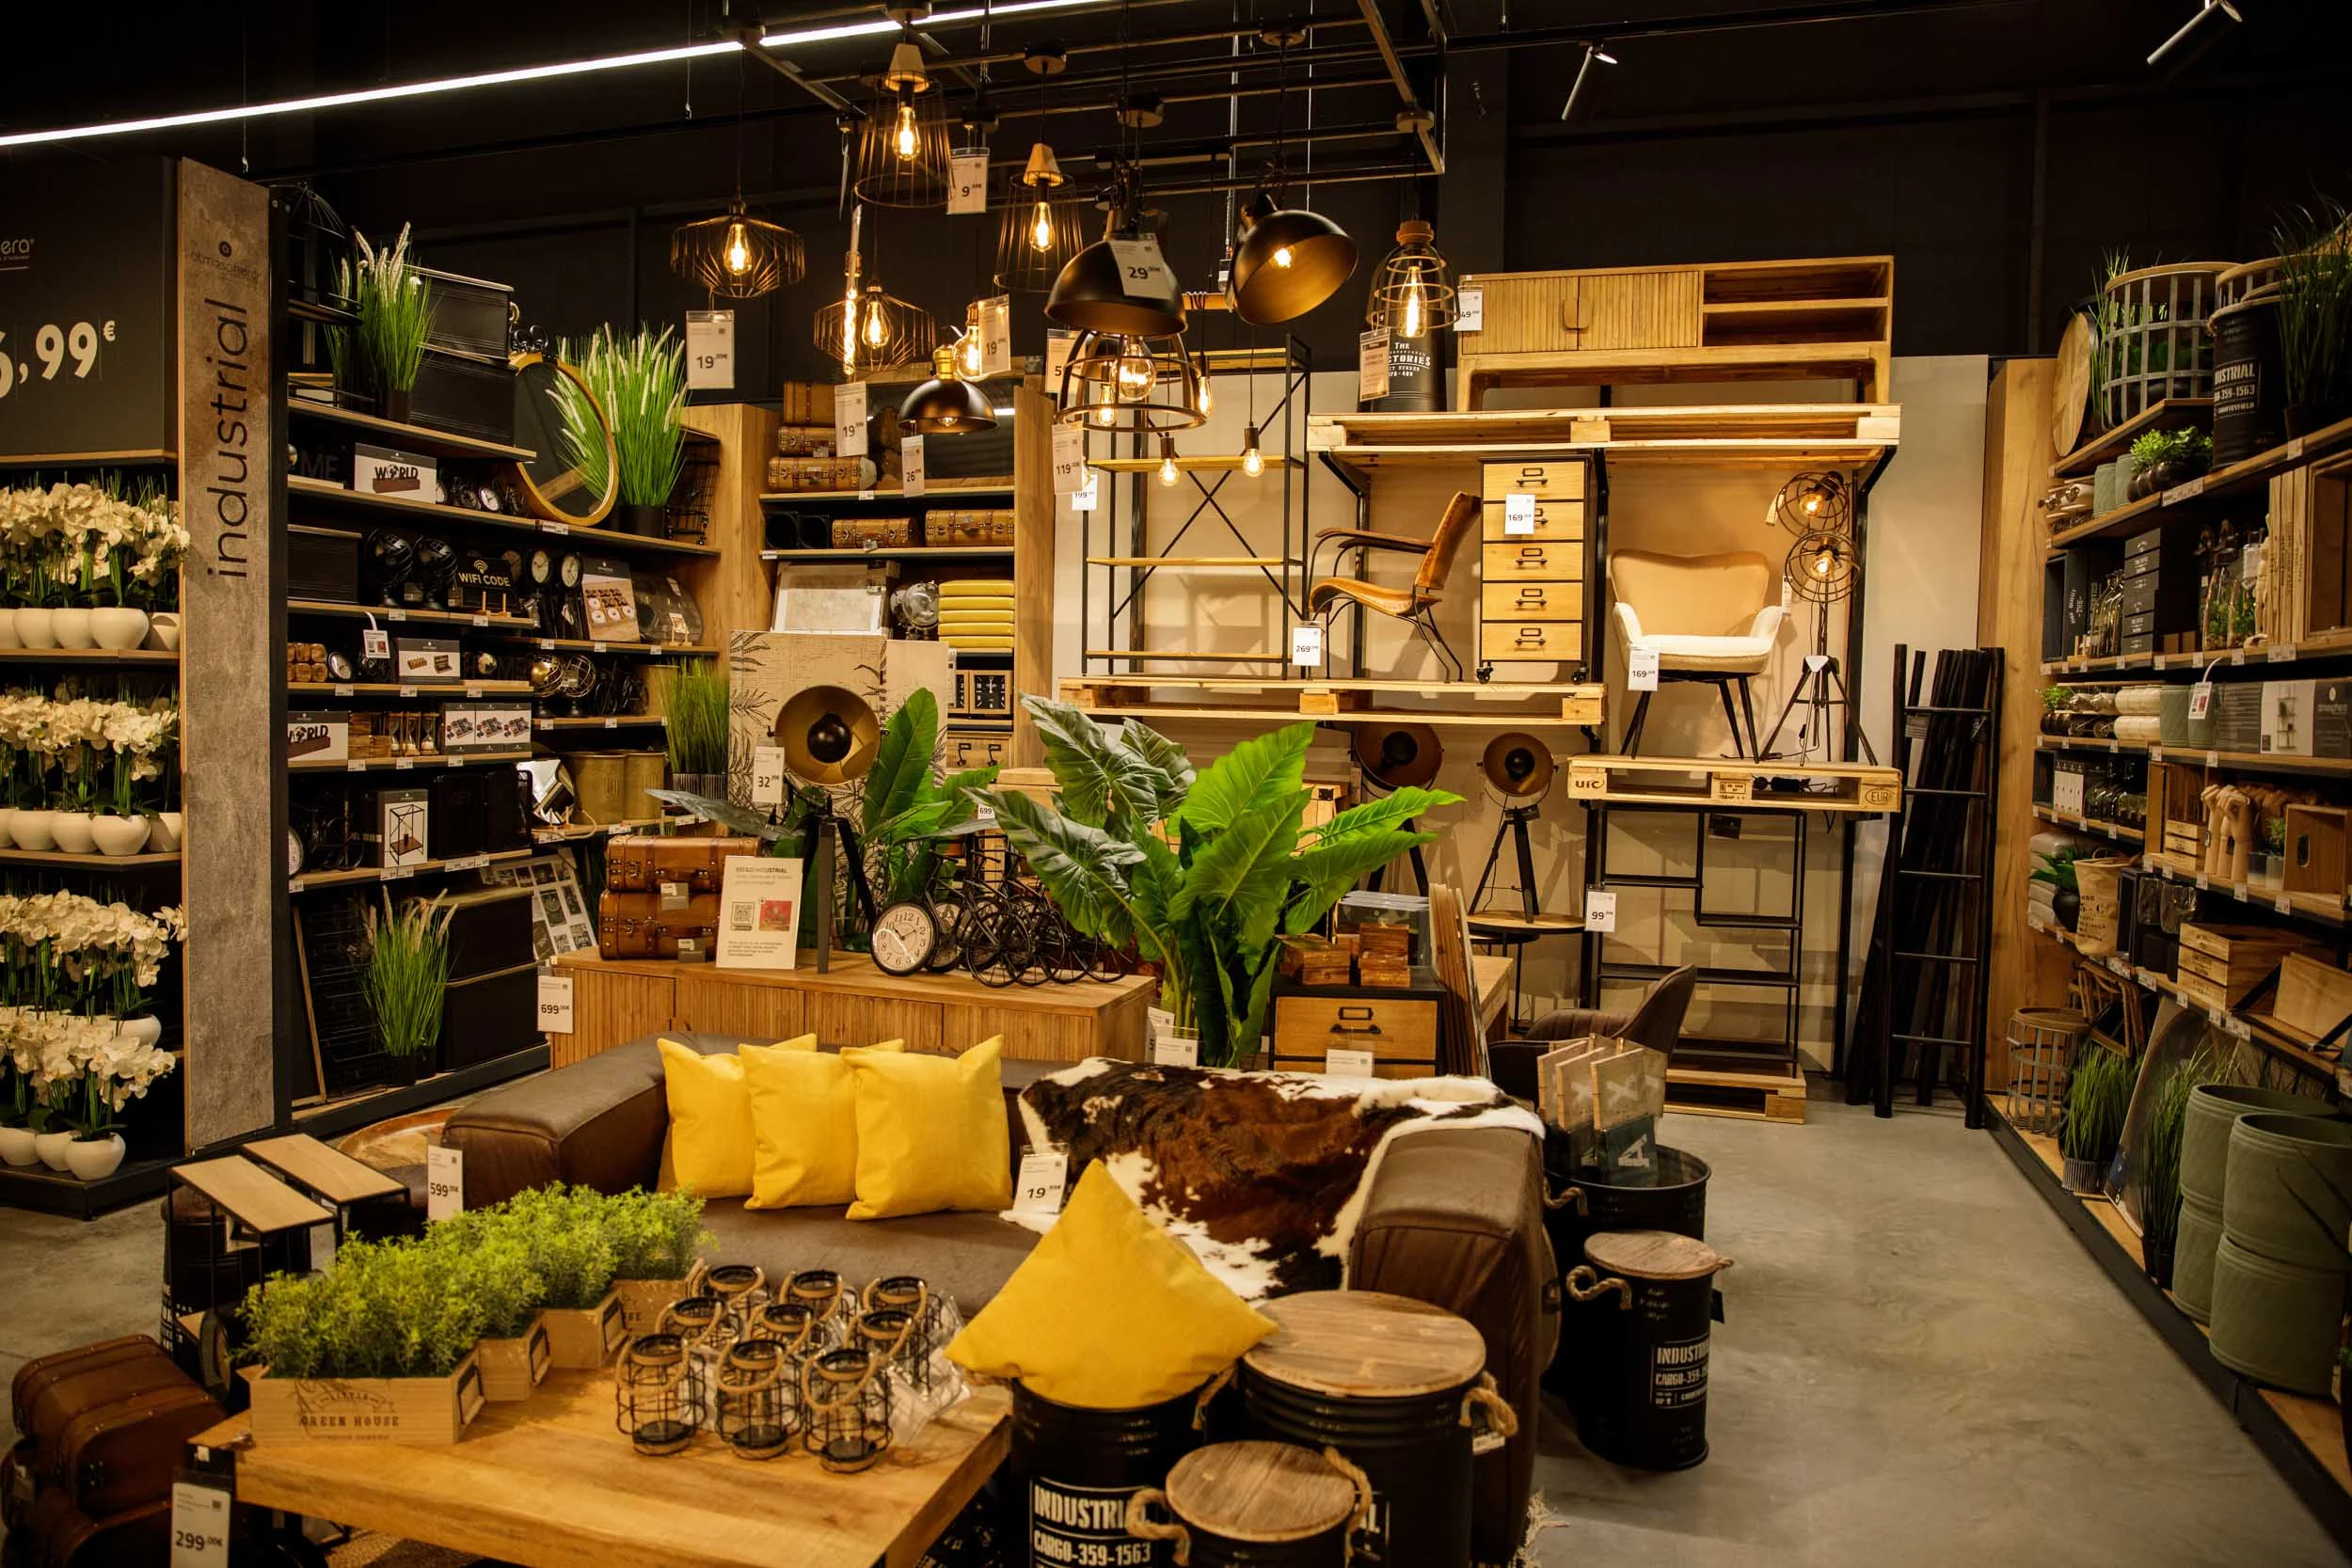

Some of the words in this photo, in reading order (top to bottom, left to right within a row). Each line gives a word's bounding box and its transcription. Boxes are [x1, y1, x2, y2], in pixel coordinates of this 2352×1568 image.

[0, 239, 30, 255] era
[696, 356, 714, 369] 19
[204, 297, 247, 578] industrial
[374, 464, 419, 480] WORLD
[483, 575, 511, 587] CODE
[758, 776, 770, 788] 32
[1870, 790, 1888, 802] EUR
[430, 1182, 449, 1196] 599
[1027, 1187, 1045, 1199] 19
[301, 1416, 345, 1426] GREEN
[354, 1416, 399, 1426] HOUSE
[1035, 1484, 1133, 1529] INDUSTRI
[176, 1531, 205, 1551] 299
[1035, 1529, 1151, 1566] CARGO-359-1563
